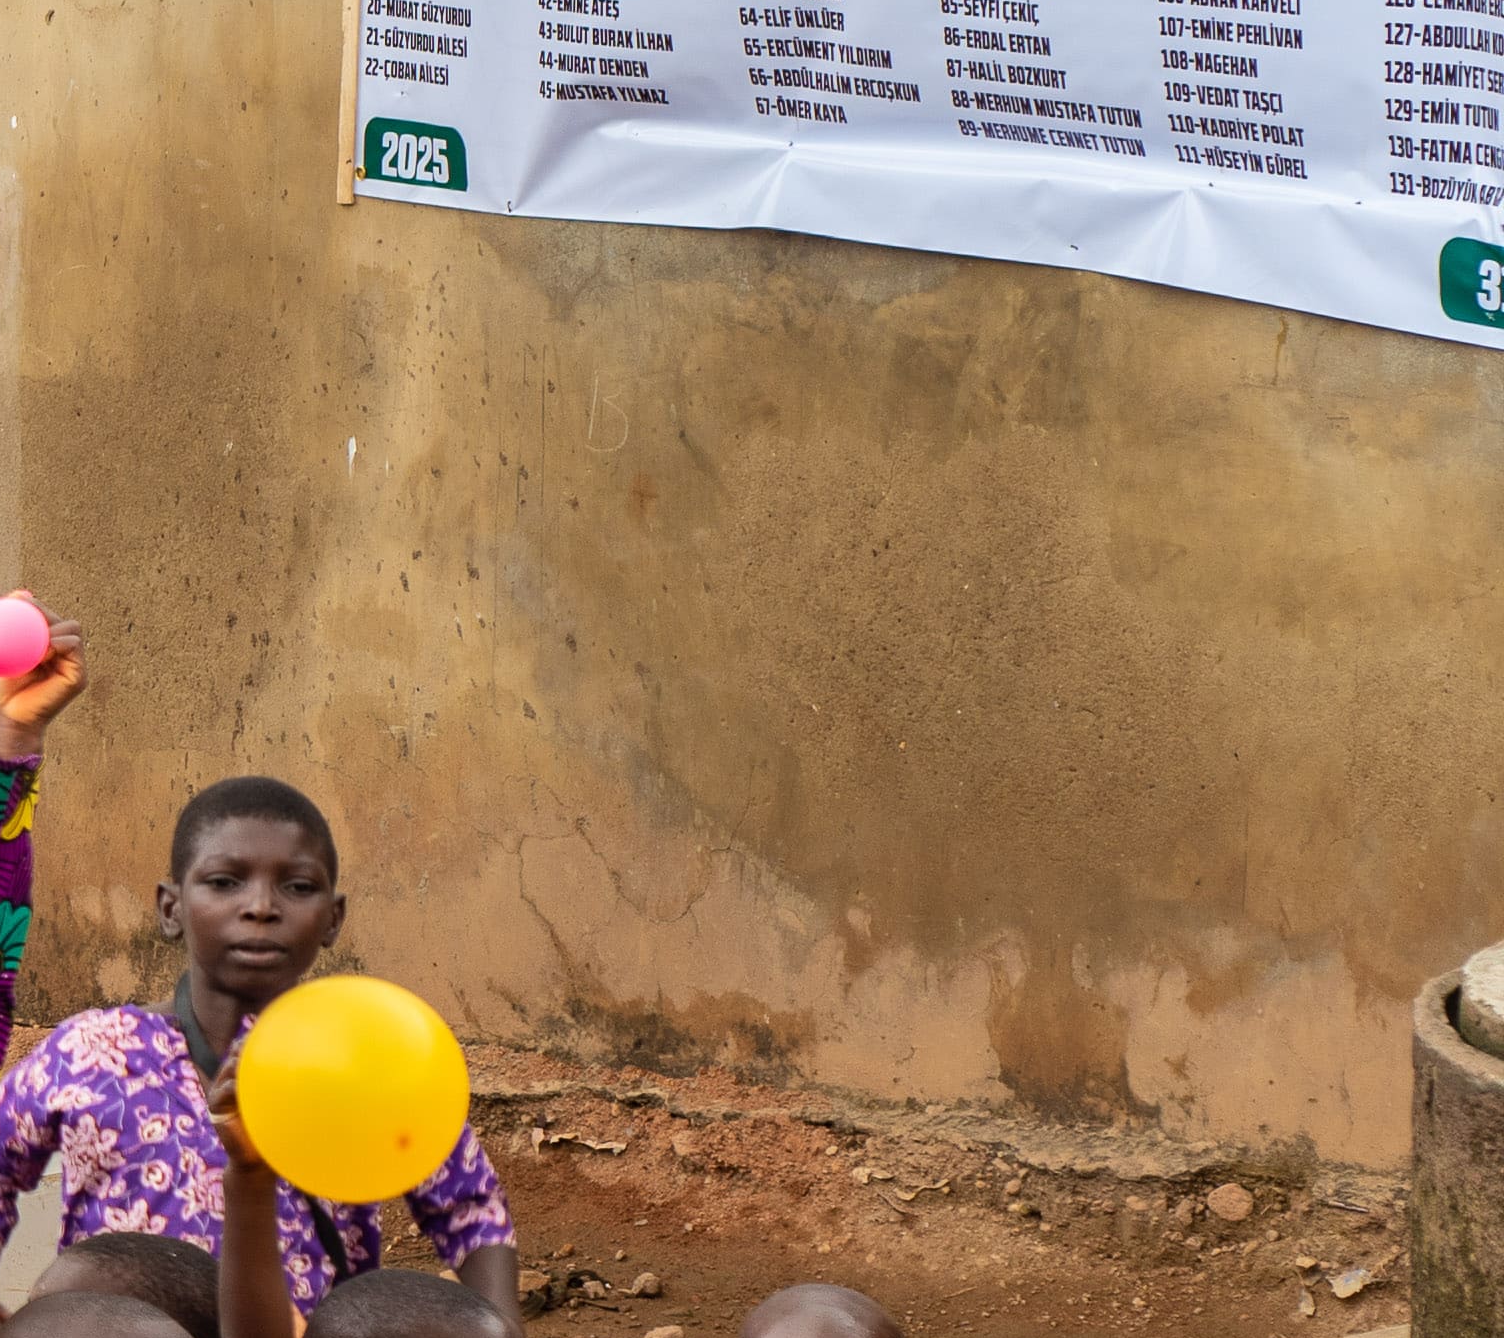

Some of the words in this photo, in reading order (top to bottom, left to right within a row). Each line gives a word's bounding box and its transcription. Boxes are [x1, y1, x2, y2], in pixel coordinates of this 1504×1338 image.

[539, 21, 589, 44] 43-BULUT
[593, 27, 633, 49] BURAK
[1007, 65, 1066, 89] BOZKURT
[1161, 49, 1257, 78] 108-NAGEHAN
[1464, 104, 1498, 131] TUTUN
[1261, 124, 1303, 147] POLAT
[381, 131, 449, 184] 2025
